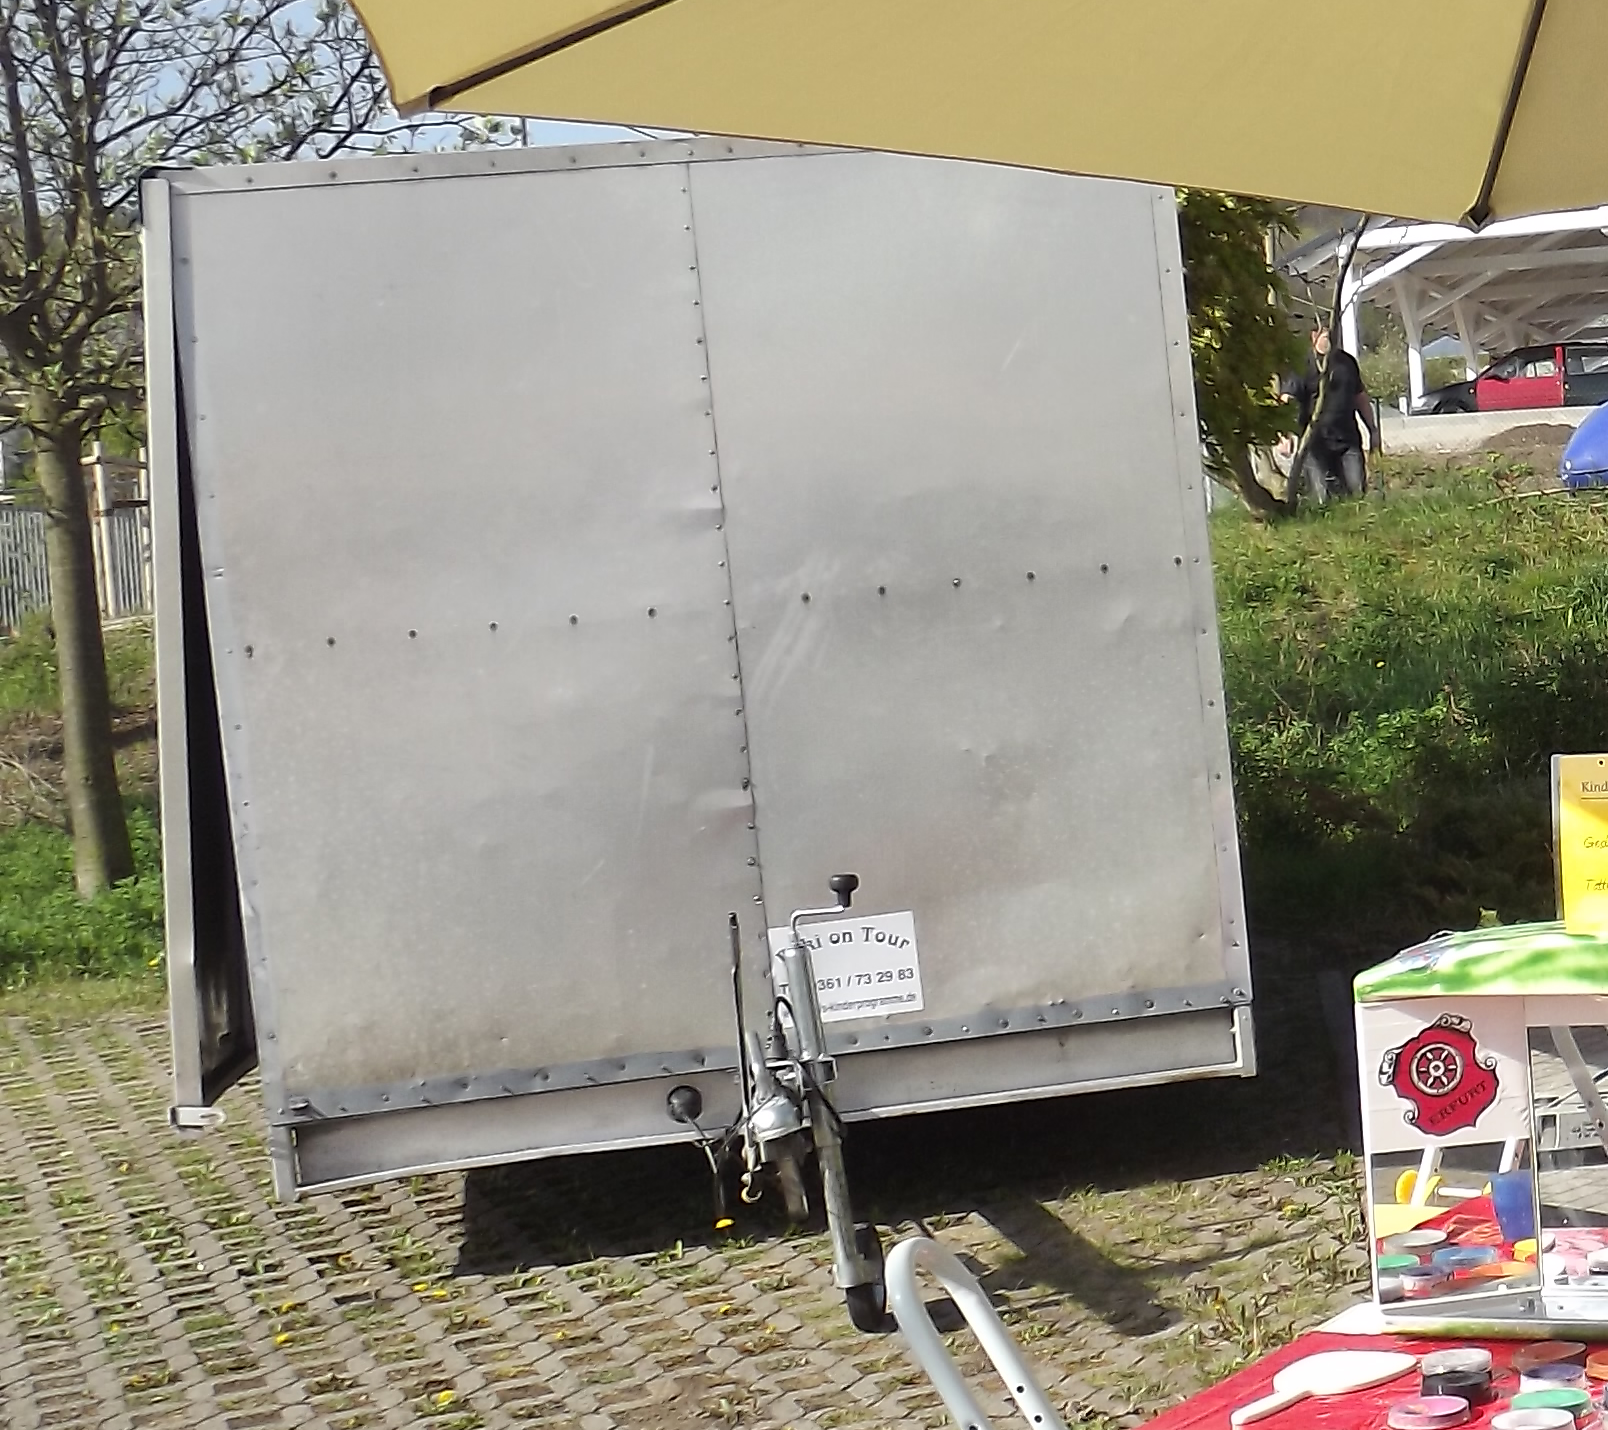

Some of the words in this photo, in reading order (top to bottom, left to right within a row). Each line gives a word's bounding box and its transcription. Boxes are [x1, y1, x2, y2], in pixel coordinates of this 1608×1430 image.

[829, 930, 853, 945] on
[860, 926, 910, 949] Tour
[817, 977, 842, 991] 361
[855, 973, 872, 986] 73
[876, 970, 893, 983] 29
[1428, 1079, 1487, 1125] ERFURT
